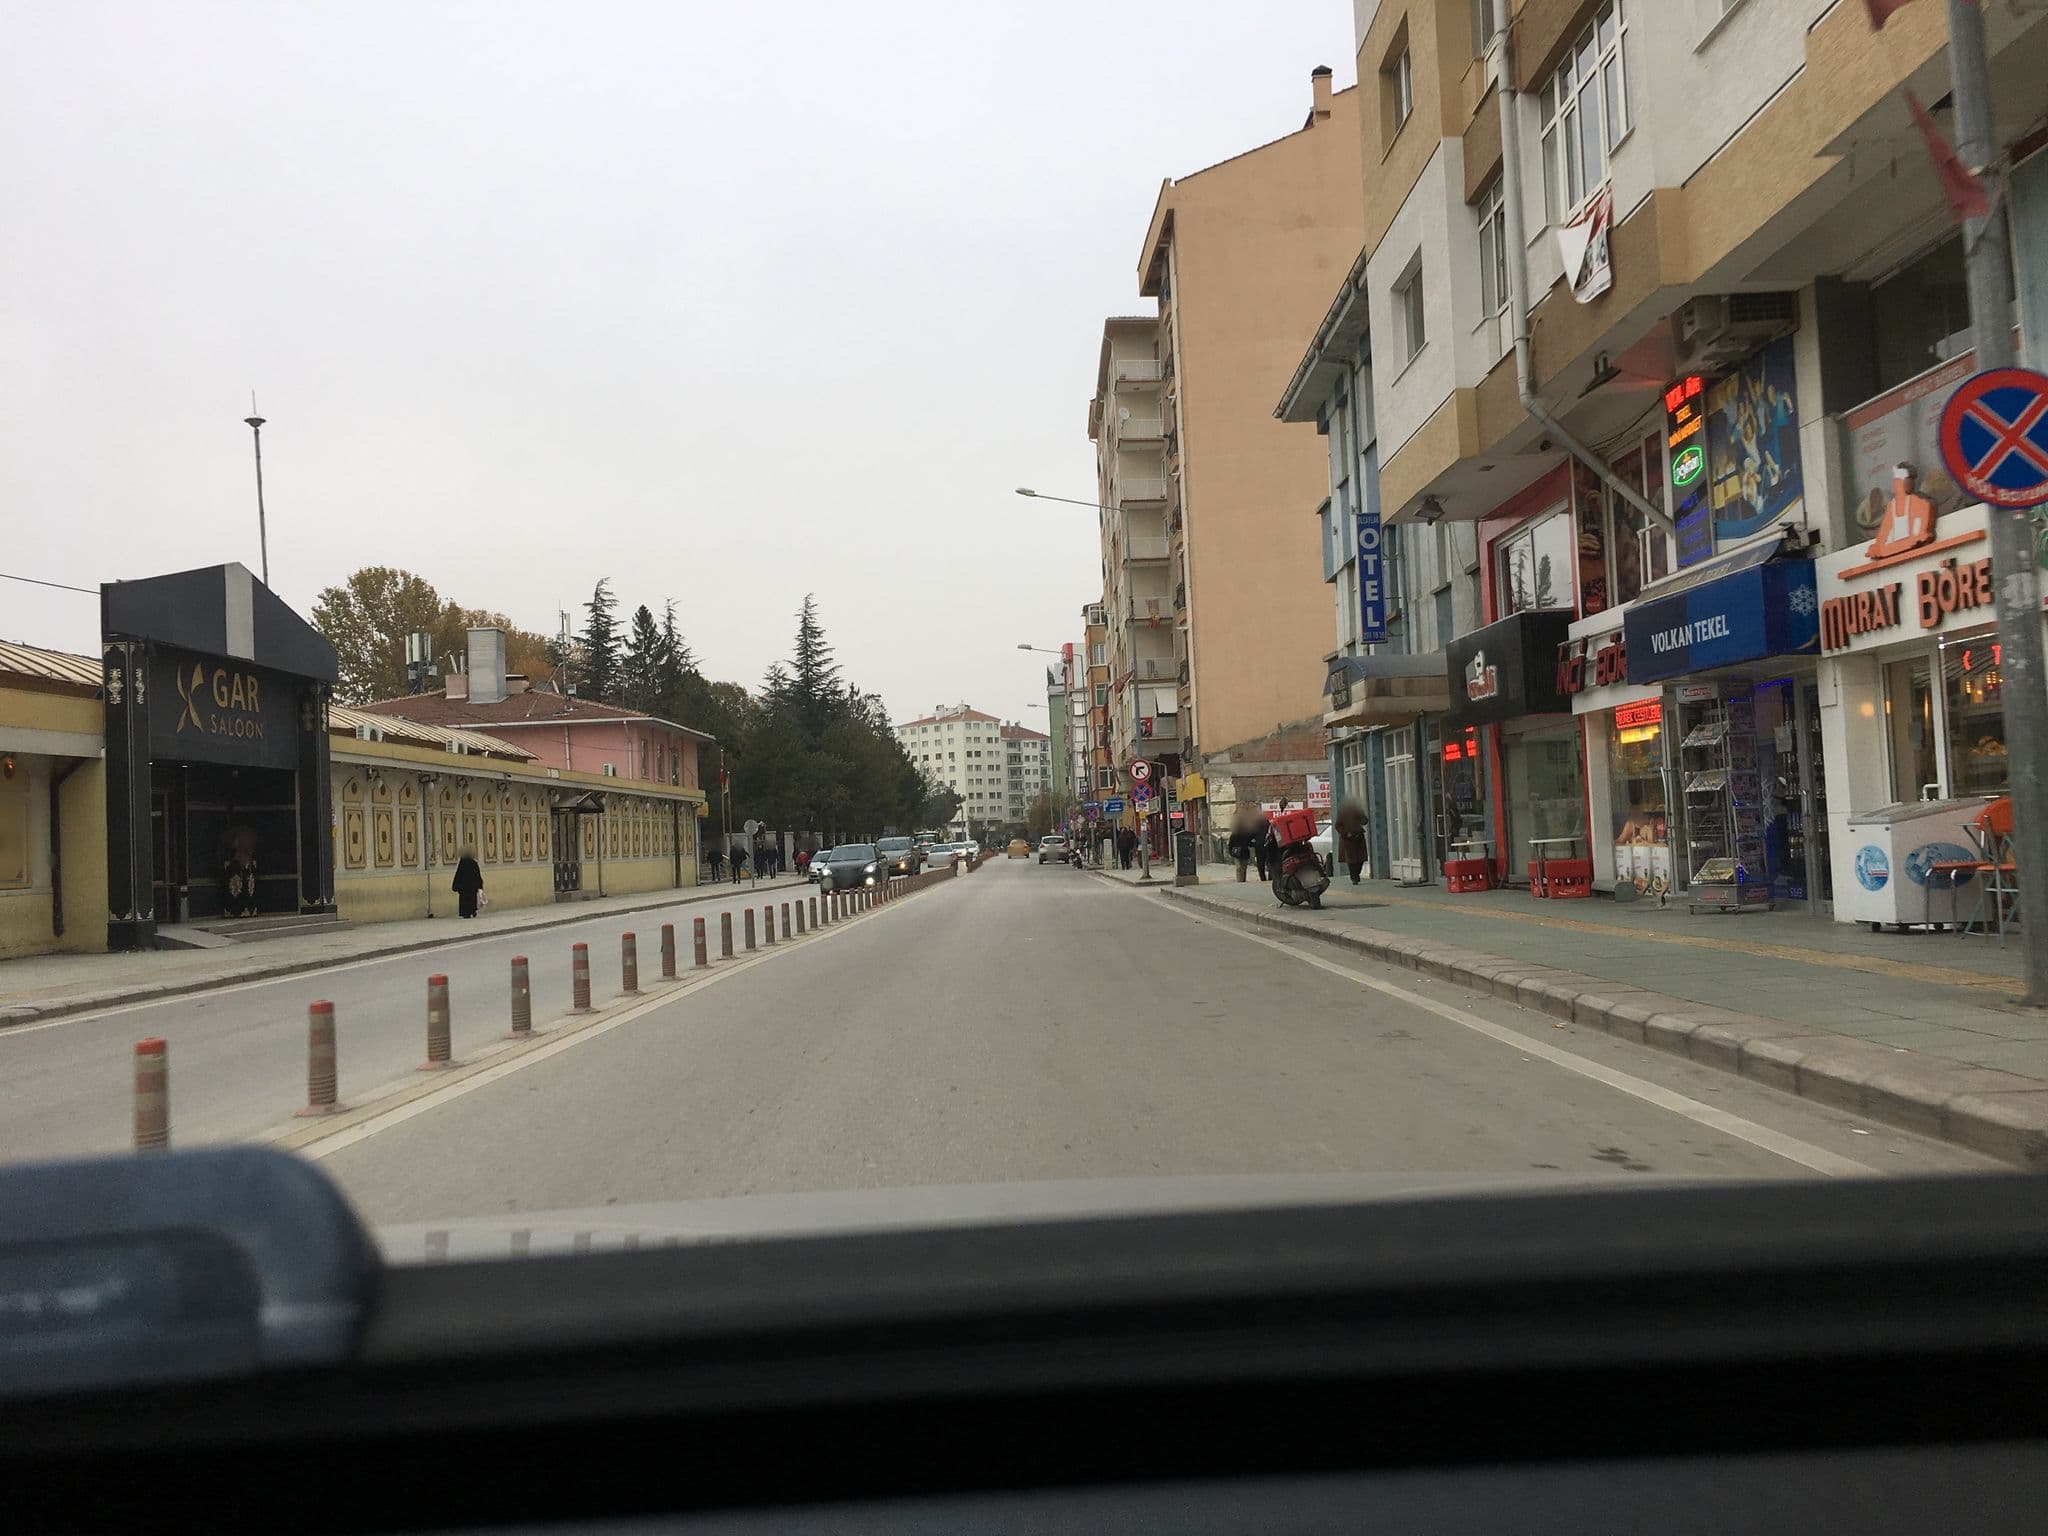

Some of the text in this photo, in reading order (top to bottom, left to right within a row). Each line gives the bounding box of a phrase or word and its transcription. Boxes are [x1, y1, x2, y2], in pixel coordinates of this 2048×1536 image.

[1359, 528, 1380, 627] OTEL
[1822, 558, 1994, 650] MURAT BÖRE
[1596, 632, 1628, 686] BÖR
[1651, 615, 1730, 654] VOLKAN TEKEL
[213, 668, 260, 713] GAR
[210, 714, 263, 739] SALOON
